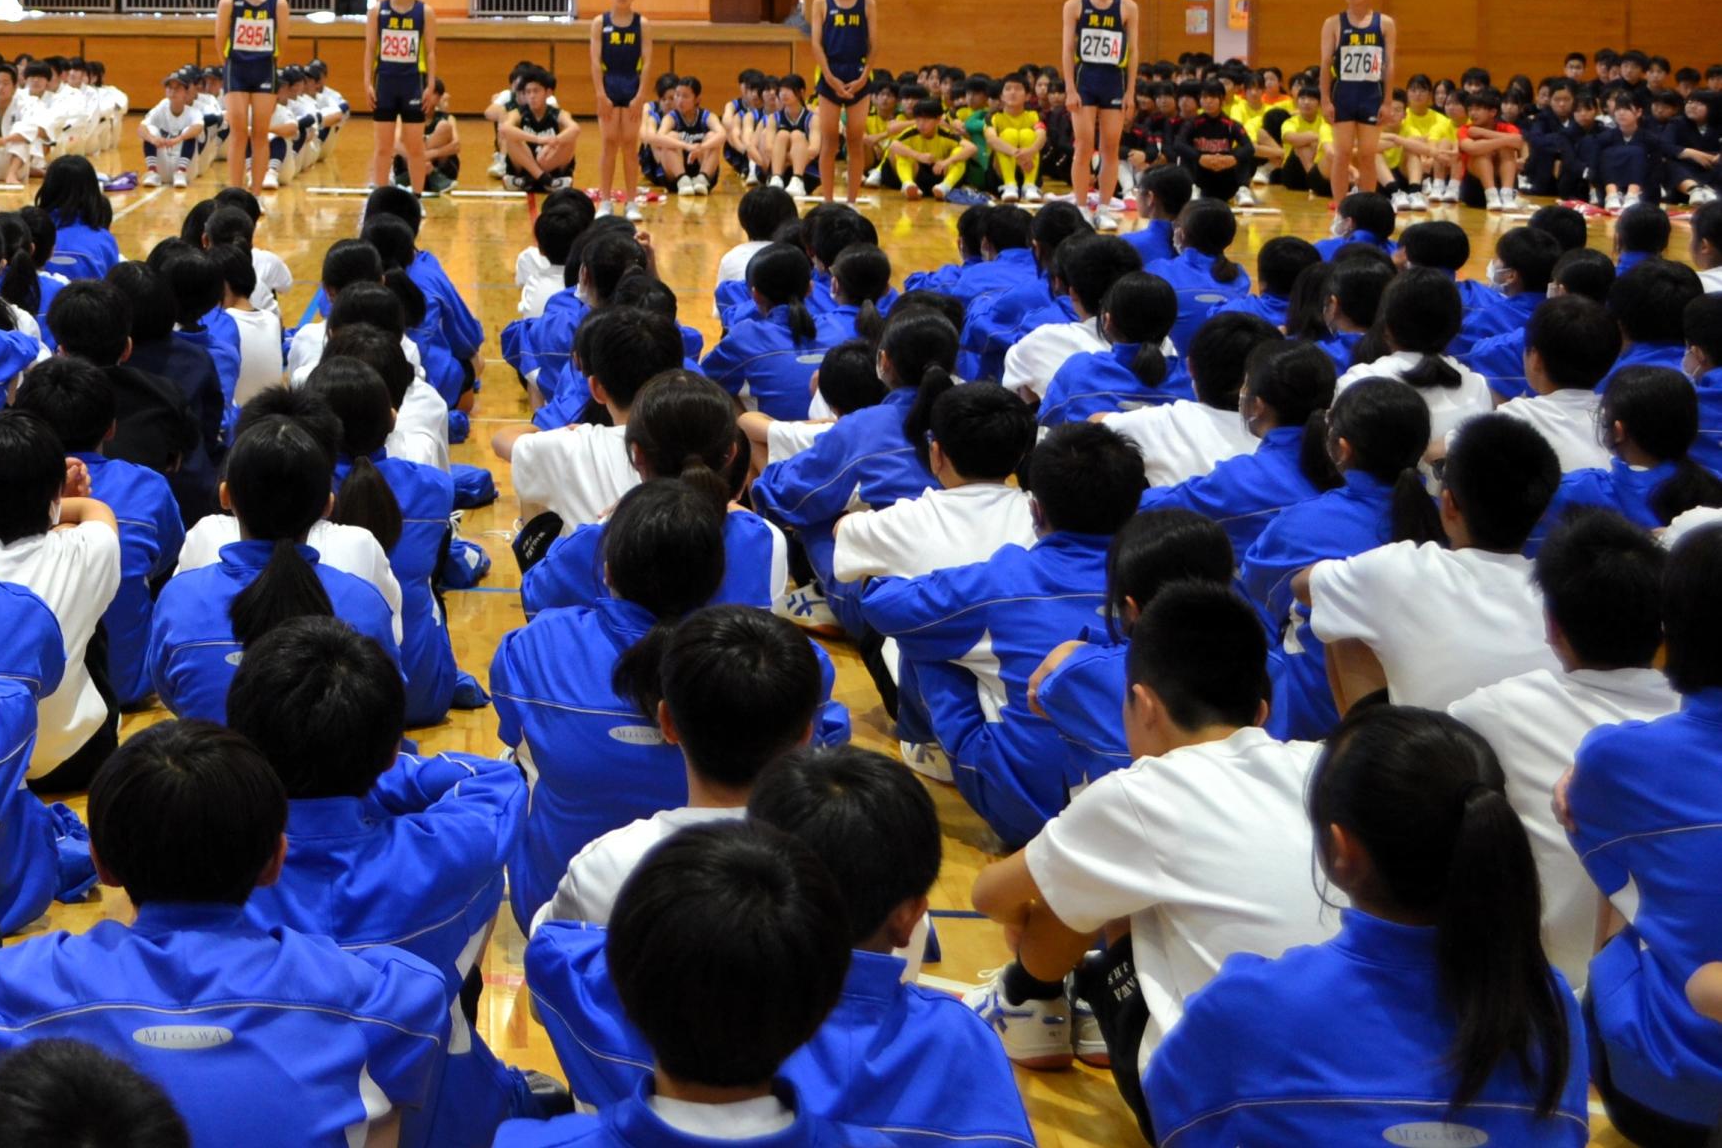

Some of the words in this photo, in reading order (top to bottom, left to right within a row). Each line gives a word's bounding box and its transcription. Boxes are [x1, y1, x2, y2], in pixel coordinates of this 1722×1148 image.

[834, 13, 861, 26] 見川
[1088, 13, 1115, 27] 見川
[236, 24, 272, 46] 295A
[610, 31, 636, 44] 見川
[1349, 33, 1377, 45] 見川
[382, 35, 416, 56] 293A
[1082, 35, 1119, 58] 275A
[1343, 52, 1379, 74] 276A
[616, 728, 663, 740] MIGAW
[144, 1029, 225, 1044] MIGAWA
[1394, 1128, 1480, 1144] MIGAWA
